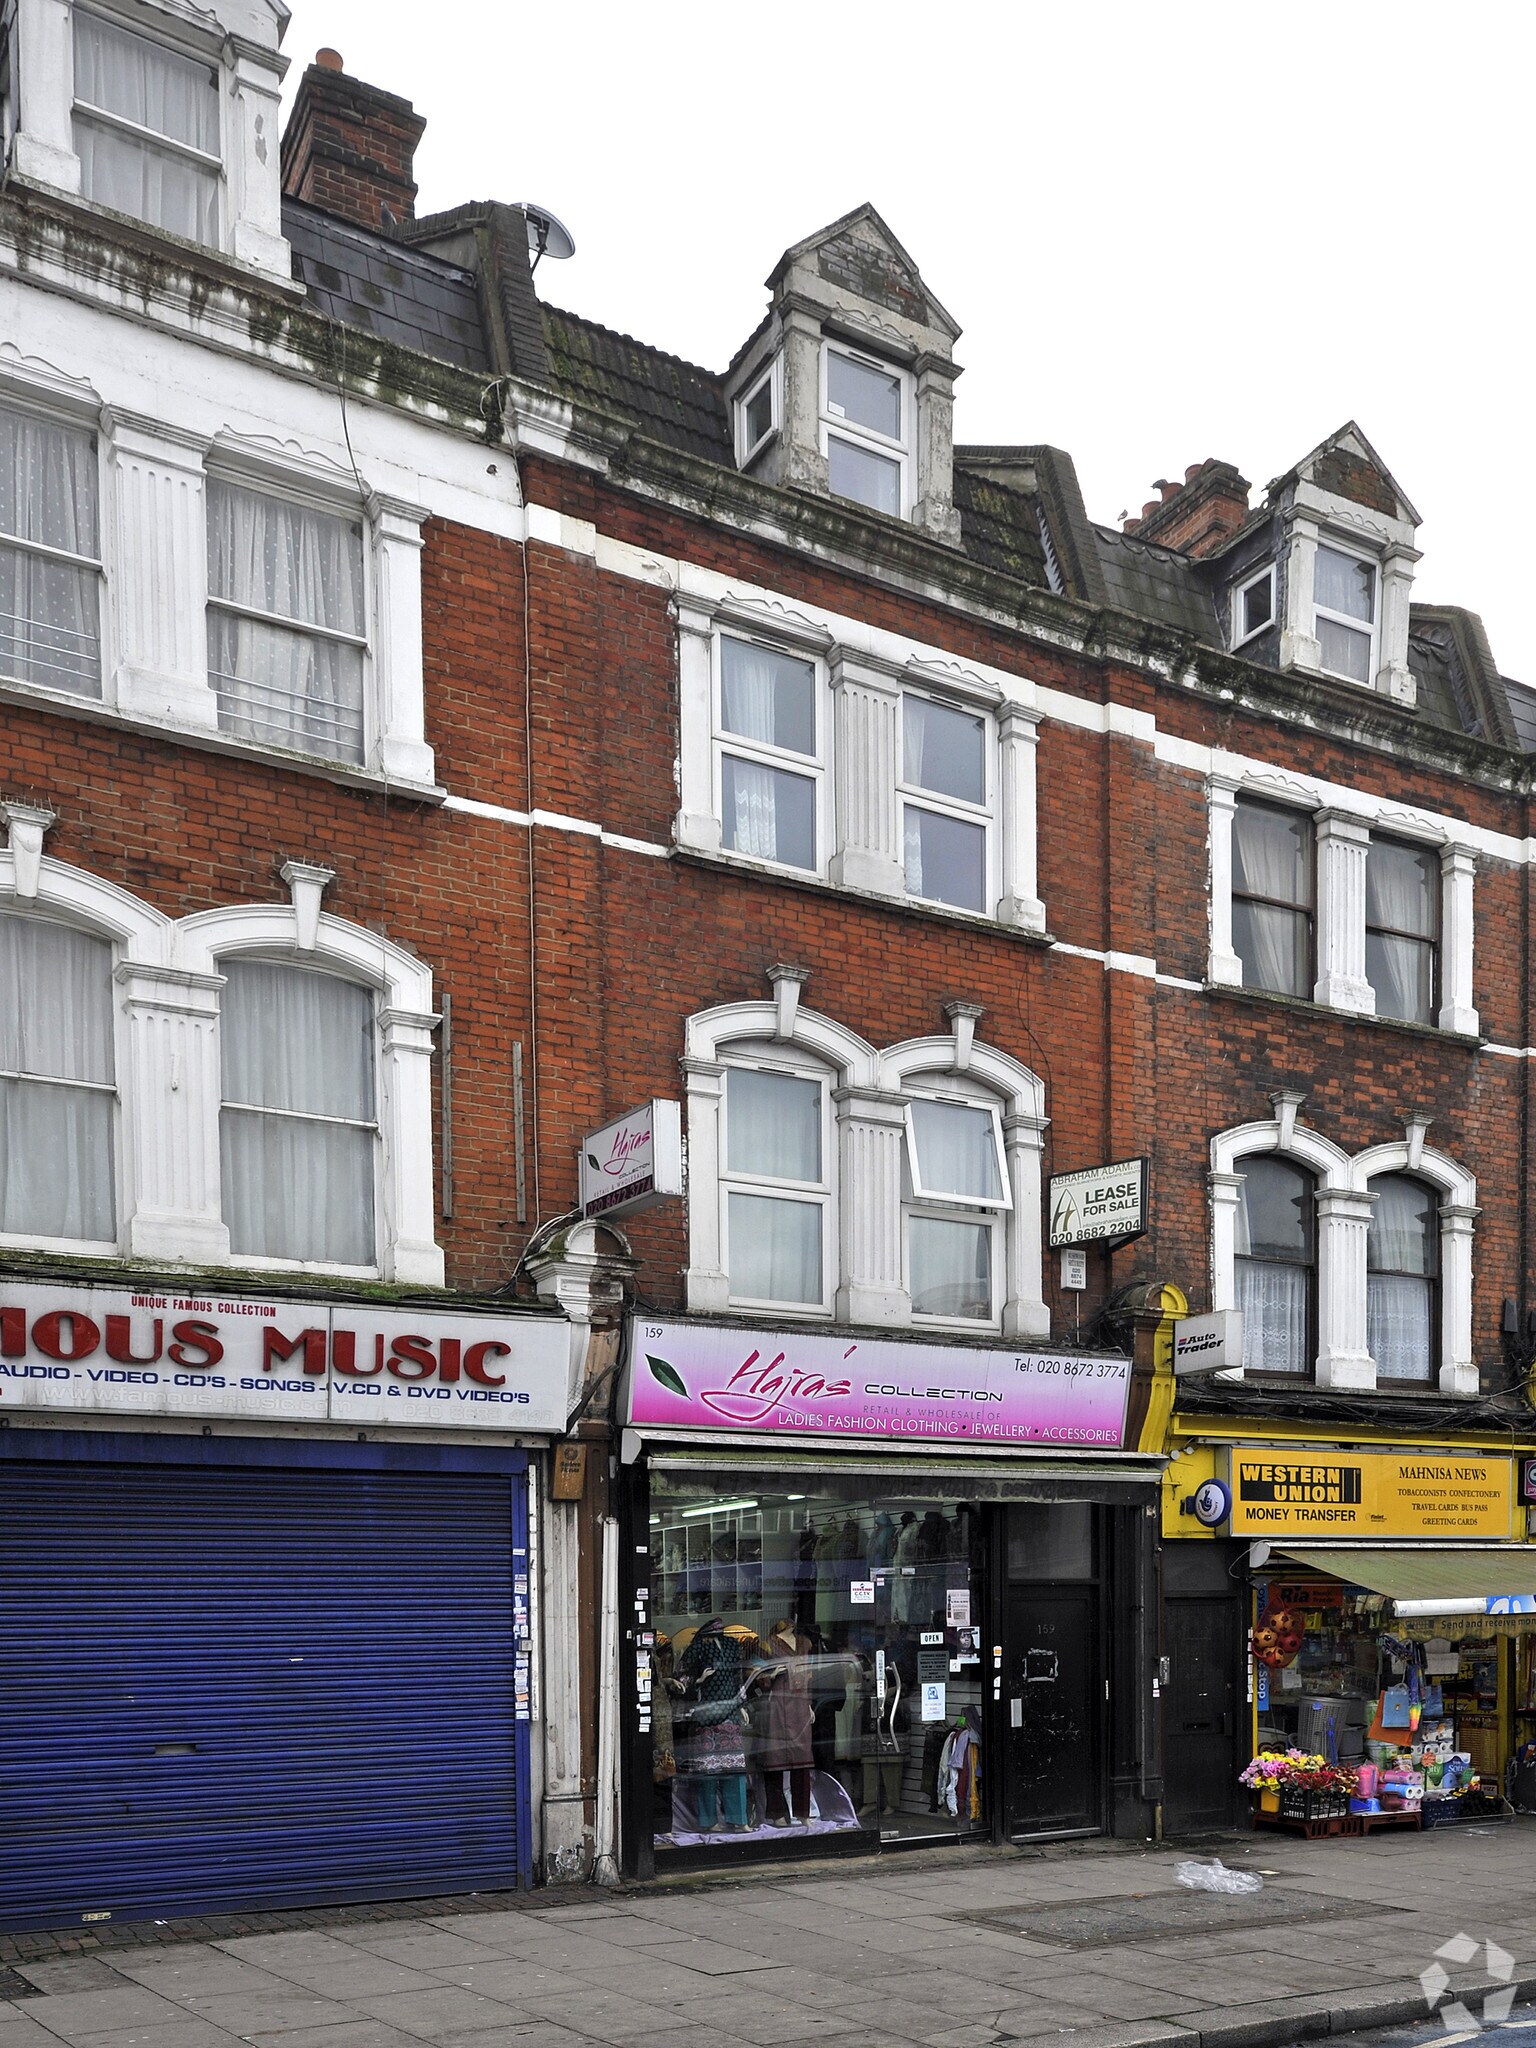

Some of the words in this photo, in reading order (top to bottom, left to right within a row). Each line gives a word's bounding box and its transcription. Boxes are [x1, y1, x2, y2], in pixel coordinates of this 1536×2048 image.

[618, 1161, 651, 1179] COLLECTION
[1051, 1169, 1099, 1186] ABRAHAM
[1101, 1162, 1130, 1176] ADAM
[587, 1200, 603, 1217] 020
[605, 1188, 627, 1209] 8672
[630, 1176, 651, 1198] 3774
[1085, 1181, 1137, 1205] LEASE
[1082, 1203, 1107, 1217] FOR
[1109, 1197, 1139, 1212] SALE
[1051, 1230, 1073, 1245] 020
[1076, 1225, 1106, 1241] 8682
[1109, 1219, 1141, 1235] 2204
[131, 1295, 168, 1310] UNIQUE
[172, 1299, 213, 1313] FAMOUS
[217, 1302, 277, 1317] COLLECTION
[644, 1326, 664, 1339] 159
[1186, 1333, 1216, 1345] Auto
[262, 1325, 512, 1386] MUSIC
[1177, 1339, 1224, 1356] Trader
[1014, 1358, 1034, 1373] Tel:
[1036, 1359, 1061, 1375] 020
[1063, 1361, 1093, 1377] 8672
[1096, 1363, 1126, 1379] 3774
[0, 1364, 71, 1380] AUDIO
[86, 1369, 158, 1385] VIDEO
[173, 1373, 226, 1389] CD'S
[240, 1377, 315, 1393] SONGS
[332, 1381, 382, 1396] V.CD
[387, 1385, 401, 1397] &
[407, 1386, 451, 1400] DVD
[455, 1388, 530, 1404] VIDEO'S
[864, 1383, 1003, 1402] COLLECTION
[43, 1385, 352, 1413] www.famous-music.com
[402, 1403, 442, 1420] 020
[863, 1405, 899, 1416] RETAIL
[905, 1407, 912, 1416] &
[917, 1408, 981, 1421] WHOLESALE
[987, 1412, 1001, 1421] OF
[778, 1412, 824, 1427] LADIES
[827, 1415, 888, 1431] FASHION
[890, 1418, 959, 1434] CLOTHING
[969, 1423, 1032, 1438] JEWELLERY
[1041, 1427, 1118, 1442] ACCESSORIES
[1241, 1464, 1340, 1484] WESTERN
[1398, 1466, 1452, 1480] MAHNISA
[1454, 1467, 1487, 1481] NEWS
[1273, 1484, 1340, 1502] UNION
[1397, 1488, 1447, 1497] TOBACCONISTS
[1449, 1489, 1501, 1498] CONFECTONERY
[1245, 1507, 1290, 1520] MONEY
[1294, 1508, 1356, 1522] TRANSFER
[1411, 1503, 1437, 1511] TRAVEL
[1438, 1503, 1459, 1511] CARDS
[1461, 1504, 1474, 1512] BUS
[1474, 1504, 1488, 1512] PASS
[1422, 1517, 1457, 1526] GREETING
[1457, 1518, 1478, 1526] CARDS
[1280, 1586, 1310, 1602] Ria
[1036, 1624, 1055, 1635] 159
[1441, 1619, 1464, 1630] Send
[1465, 1618, 1482, 1628] and
[1485, 1616, 1516, 1628] receive
[924, 1635, 940, 1643] OPEN
[1257, 1671, 1268, 1699] Stop
